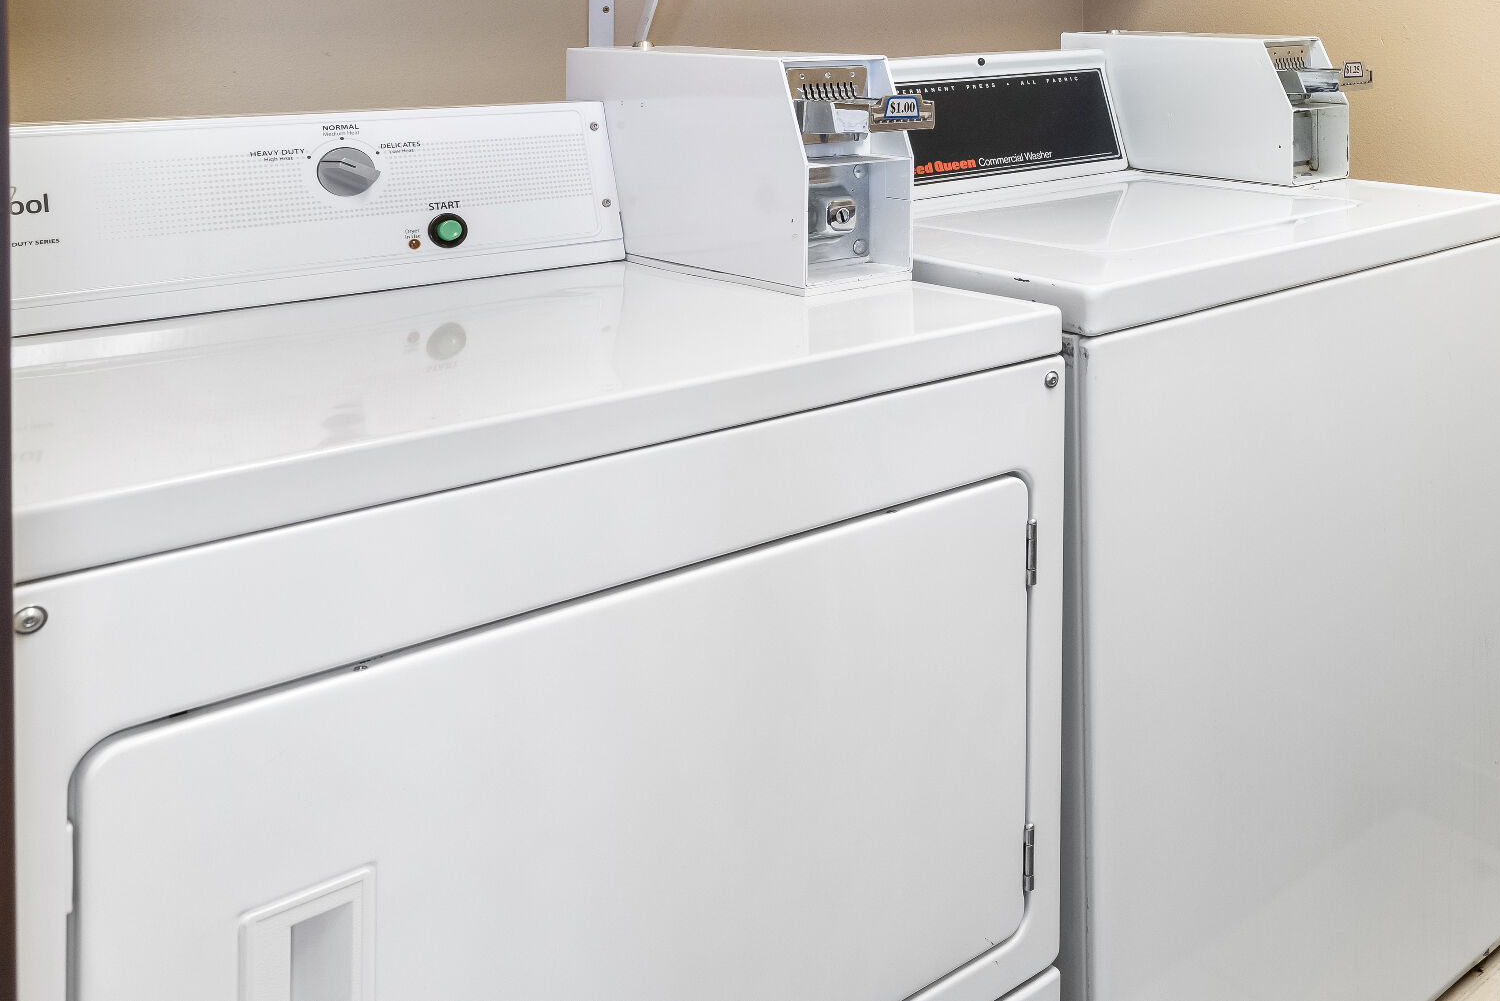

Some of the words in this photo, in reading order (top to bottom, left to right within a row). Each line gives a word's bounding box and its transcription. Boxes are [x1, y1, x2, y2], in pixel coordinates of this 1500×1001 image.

[965, 82, 996, 90] PRESS
[1046, 76, 1079, 84] FABRIC
[889, 101, 916, 114] $1.00
[322, 123, 360, 131] NORMAL
[380, 141, 421, 149] DELICATES
[249, 149, 279, 158] HEAVY
[281, 148, 305, 156] DUTY
[934, 157, 977, 173] Queen
[978, 152, 1024, 167] Commercial
[1024, 150, 1053, 161] Washer
[428, 200, 461, 211] START
[11, 240, 33, 248] DUTY
[34, 238, 60, 246] SERIES
